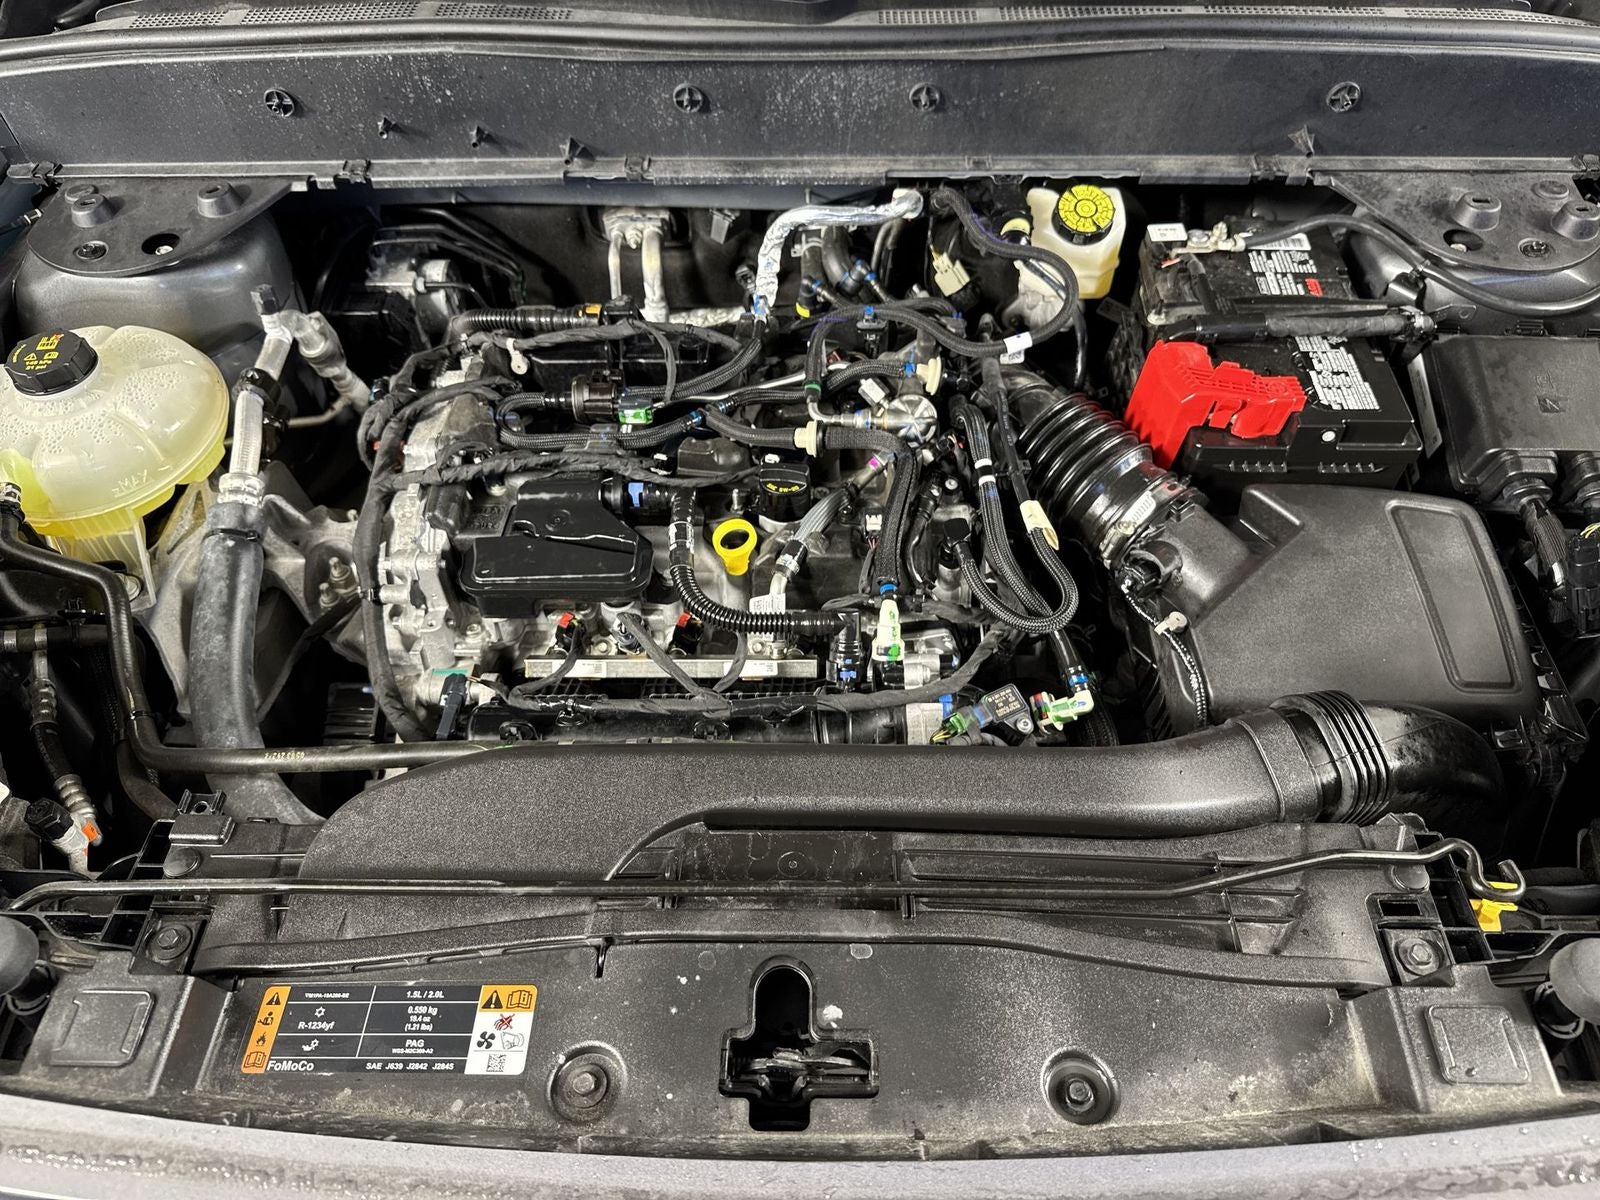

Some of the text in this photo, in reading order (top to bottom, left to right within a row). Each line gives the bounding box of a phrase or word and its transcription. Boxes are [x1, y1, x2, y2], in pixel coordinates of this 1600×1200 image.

[406, 990, 445, 999] 1.5L / 2.0L
[407, 1005, 438, 1016] 0.550 kg
[298, 1020, 335, 1031] R-1234yf
[404, 1022, 433, 1032] (1.21 lbs)
[405, 1039, 425, 1048] PAG
[266, 1060, 315, 1072] FoMoCo
[365, 1062, 383, 1070] SAE
[384, 1062, 404, 1070] J639
[405, 1062, 429, 1070] J2842
